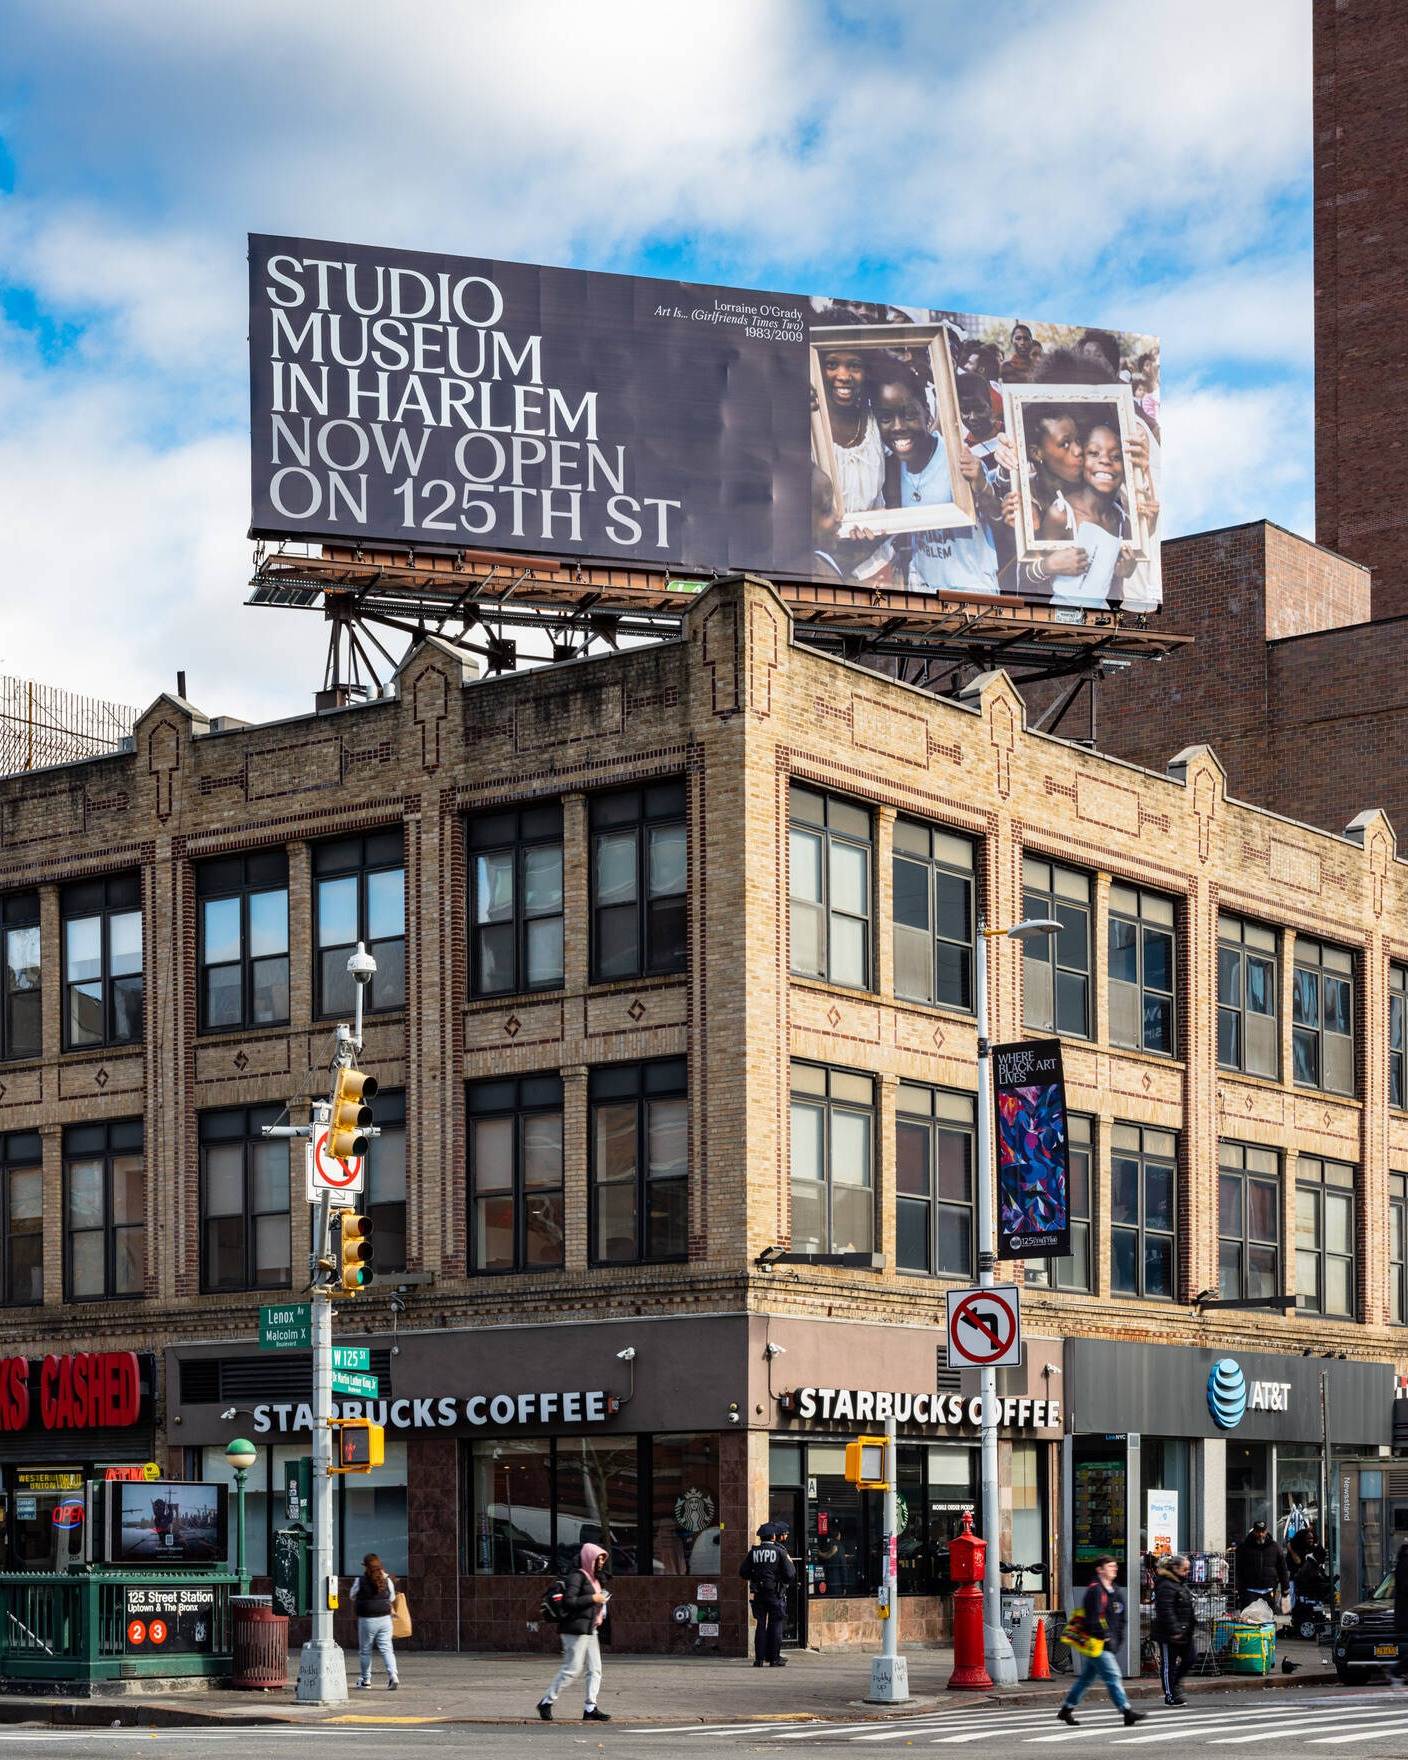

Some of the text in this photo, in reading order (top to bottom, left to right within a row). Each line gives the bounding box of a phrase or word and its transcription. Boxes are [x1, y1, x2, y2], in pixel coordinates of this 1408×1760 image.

[266, 255, 504, 328] STUDIO
[654, 305, 671, 317] Art
[691, 309, 748, 325] (Girlfriends
[752, 316, 779, 329] Times
[781, 319, 804, 331] Two)
[714, 299, 803, 321] Lorraine O'Grady
[744, 327, 803, 342] 1983/2009
[270, 308, 542, 385] MUSEUM
[270, 361, 599, 441] IN HARLEM
[270, 413, 626, 494] NOW OPEN
[269, 466, 681, 549] ON 125TH ST
[998, 1051, 1035, 1064] WHERE
[999, 1058, 1057, 1075] BLACK ART
[1000, 1071, 1027, 1085] LIVES
[268, 1306, 304, 1324] Lenox Av
[266, 1328, 306, 1341] Malcolm X
[333, 1350, 341, 1366] W
[344, 1351, 358, 1367] 125
[41, 1352, 140, 1430] CASHED
[1249, 1381, 1291, 1411] AT&T
[465, 1391, 606, 1427] COFFEE
[800, 1388, 963, 1425] STARBUCKS
[808, 1480, 816, 1493] A
[1343, 1477, 1351, 1521] Newsstand
[52, 1505, 85, 1523] OPEN
[753, 1550, 777, 1563] NYPD
[128, 1591, 213, 1603] 125 Street Station
[127, 1603, 154, 1614] Uptown
[164, 1603, 176, 1612] The
[179, 1603, 198, 1612] Bronx
[133, 1624, 162, 1639] 2 3
